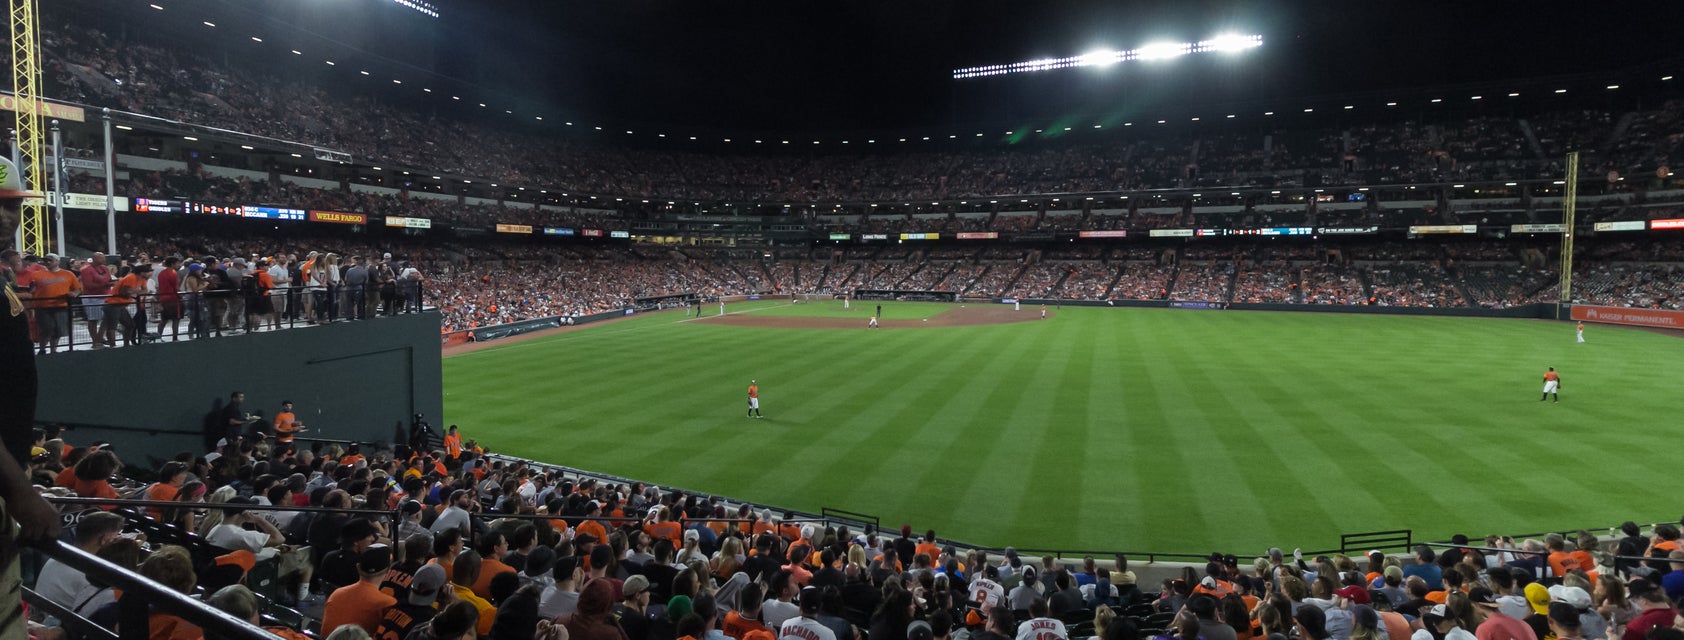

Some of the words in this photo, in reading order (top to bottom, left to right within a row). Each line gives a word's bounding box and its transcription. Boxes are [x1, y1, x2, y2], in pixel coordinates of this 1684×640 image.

[210, 206, 217, 214] 2
[235, 207, 242, 215] 2
[316, 212, 340, 221] WELLS
[340, 214, 363, 222] FARGO
[1599, 313, 1623, 321] KAISER
[975, 589, 987, 603] 8
[1030, 622, 1057, 632] JONES
